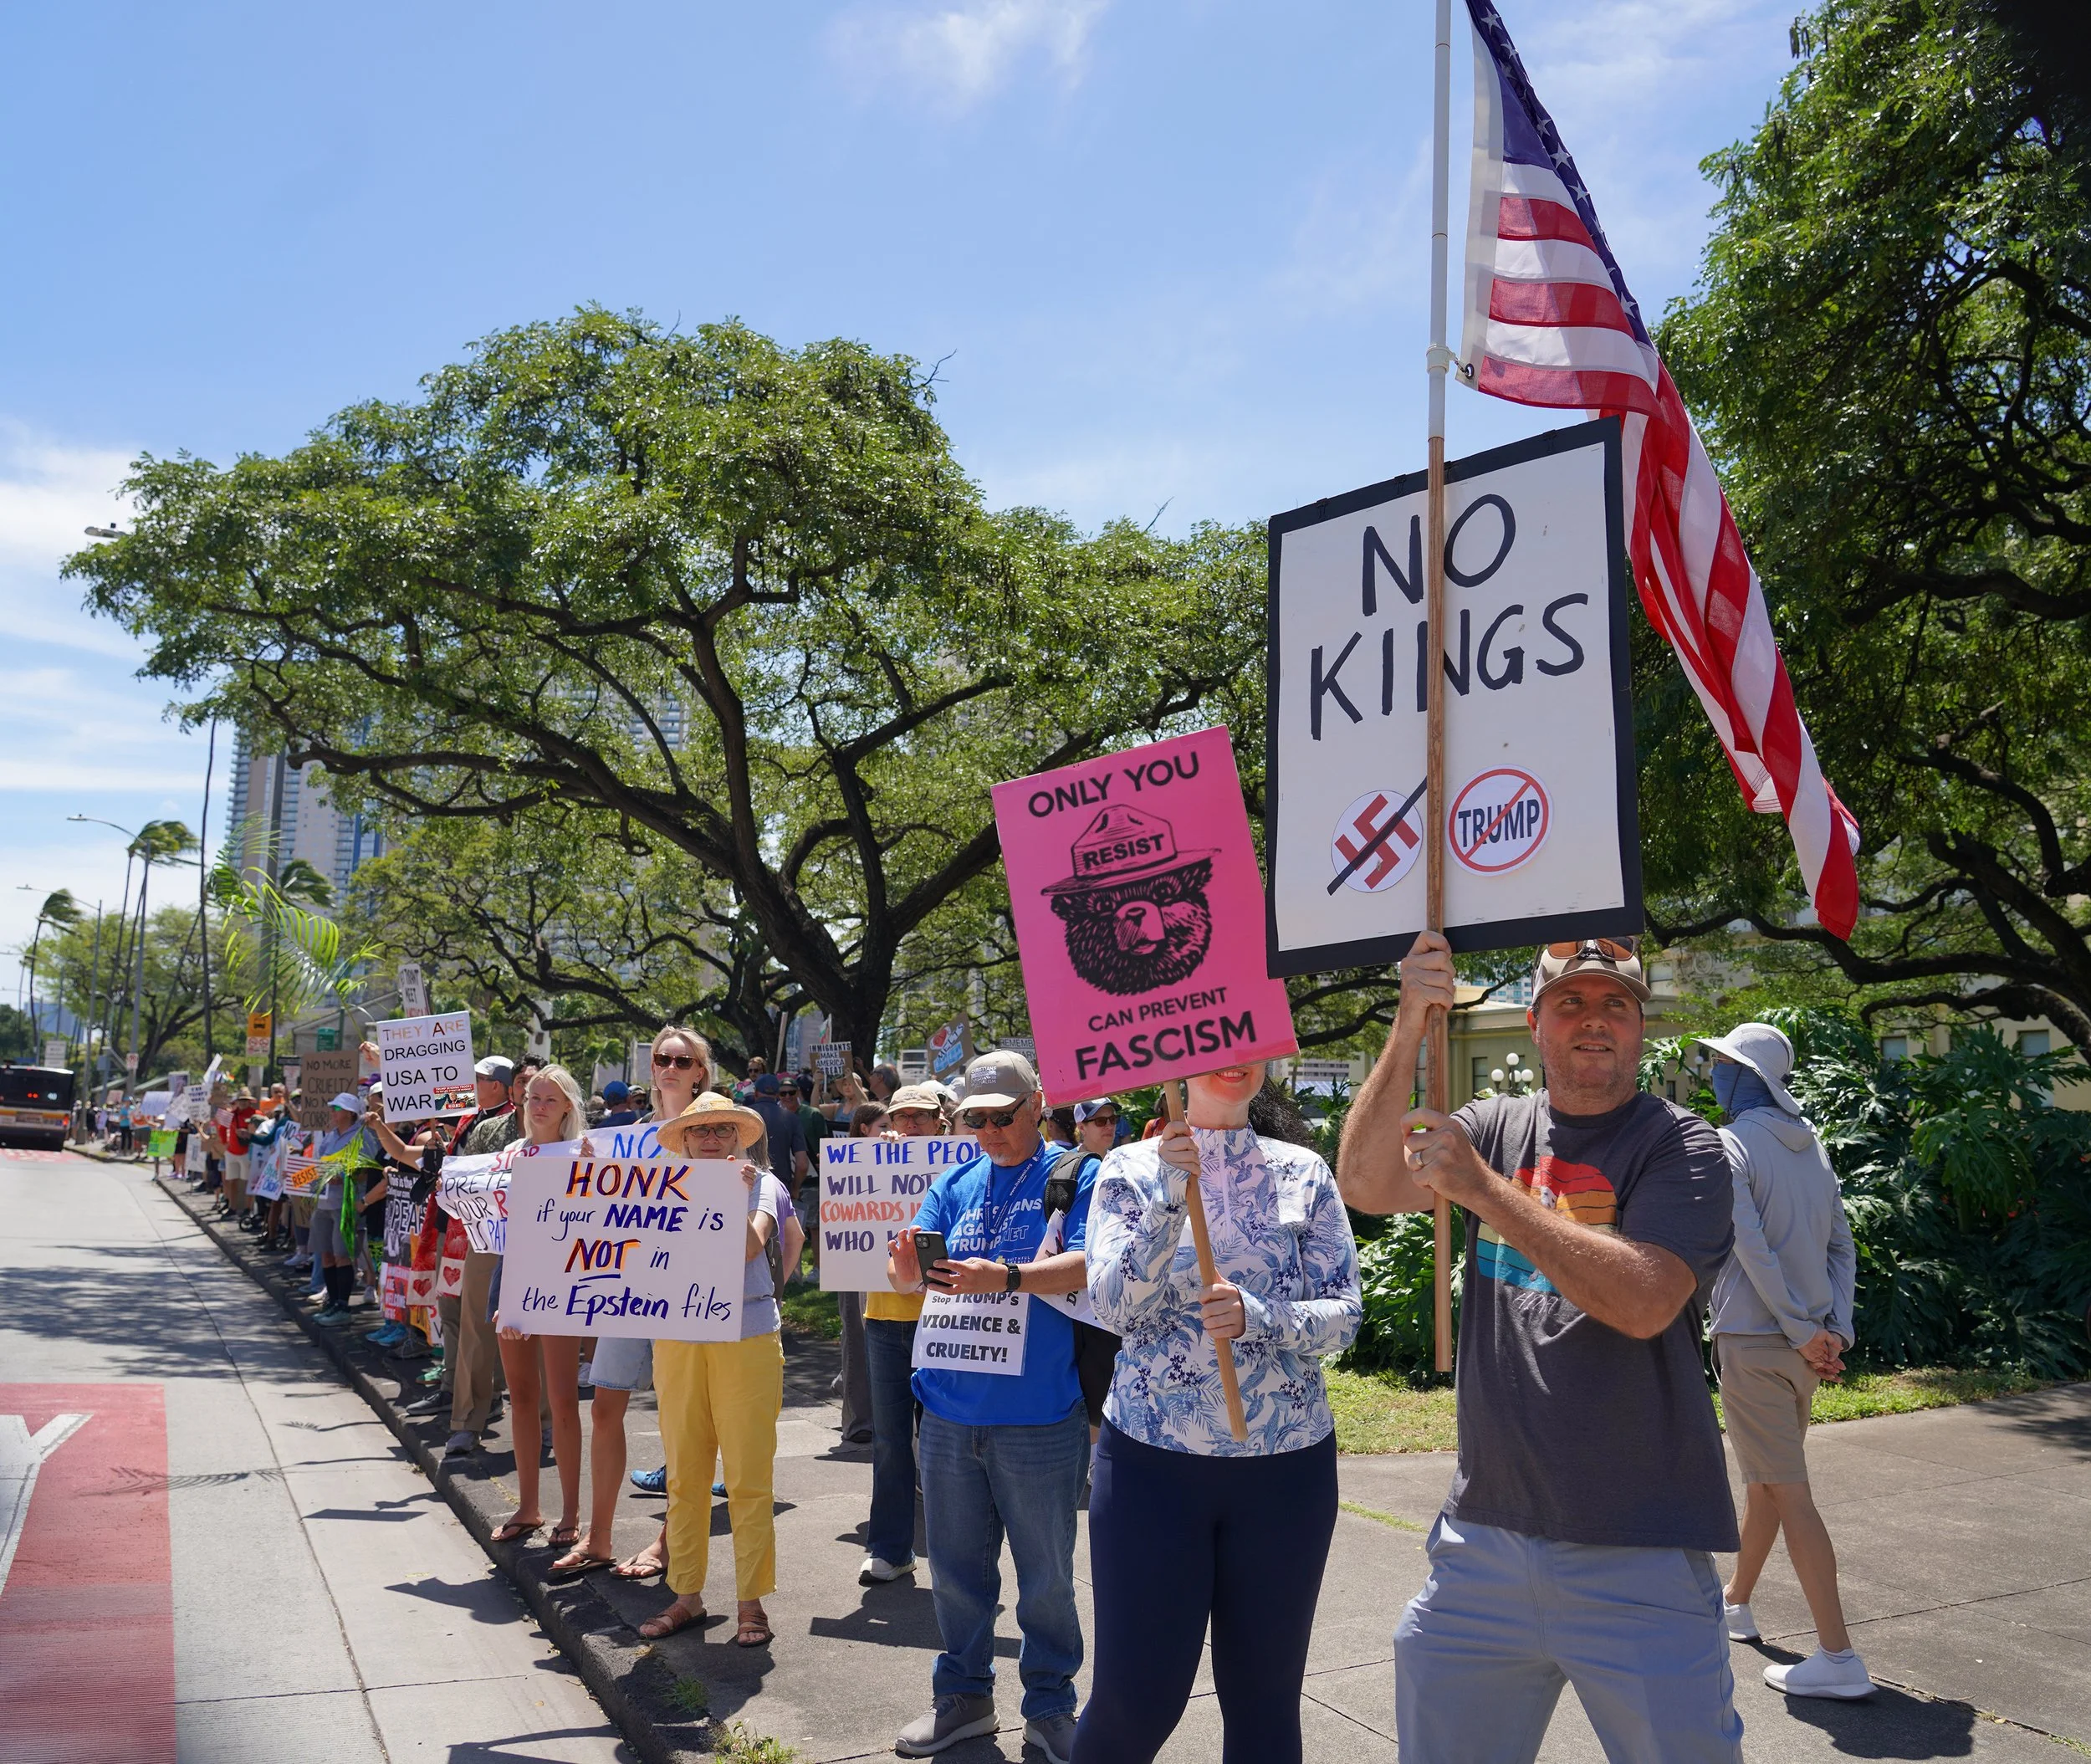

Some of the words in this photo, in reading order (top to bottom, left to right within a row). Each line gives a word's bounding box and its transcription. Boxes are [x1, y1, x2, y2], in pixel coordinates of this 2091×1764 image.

[1362, 494, 1516, 616] NO
[1311, 593, 1588, 741] KINGS
[1028, 773, 1112, 818] ONLY
[1124, 751, 1200, 792] YOU
[1458, 798, 1540, 848] TRUMP
[1082, 834, 1164, 870] RESIST
[1088, 1009, 1134, 1032] CAN
[1140, 988, 1227, 1022] PREVENT
[382, 1025, 422, 1041] THEY
[432, 1019, 466, 1038] ARE
[384, 1040, 466, 1061] DRAGGING
[809, 1042, 851, 1052] IMMIGRANTS
[1000, 1039, 1034, 1047] REMEMB
[1075, 1010, 1257, 1081] FASCISM
[306, 1061, 320, 1071] NO
[322, 1059, 352, 1071] MORE
[816, 1058, 845, 1066] AMERICA
[308, 1076, 355, 1095] CRUELTY
[386, 1069, 427, 1087] USA
[432, 1066, 458, 1082] TO
[304, 1096, 319, 1109] NO
[387, 1094, 432, 1112] WAR
[282, 1122, 296, 1140] NO
[826, 1141, 862, 1164] WE
[872, 1141, 916, 1165] THE
[927, 1140, 984, 1165] PEO
[292, 1167, 317, 1188] RESIST
[445, 1169, 512, 1199] PRETE
[565, 1161, 693, 1201] HONK
[827, 1174, 882, 1196] WILL
[891, 1172, 941, 1196] NOT
[391, 1198, 421, 1236] PEA
[446, 1196, 493, 1222] YOUR
[536, 1198, 555, 1222] if
[552, 1209, 596, 1241] your
[603, 1203, 689, 1233] NAME
[698, 1207, 724, 1231] is
[820, 1200, 905, 1224] COWARDS
[826, 1230, 875, 1253] WHO
[565, 1238, 641, 1273] NOT
[650, 1246, 670, 1271] in
[521, 1286, 559, 1311] the
[565, 1285, 669, 1327] Epstein
[681, 1283, 732, 1322] files
[932, 1296, 952, 1305] Stop
[923, 1314, 1003, 1333] VIOLENCE
[1007, 1318, 1021, 1335] &
[926, 1342, 1009, 1363] CRUELTY!
